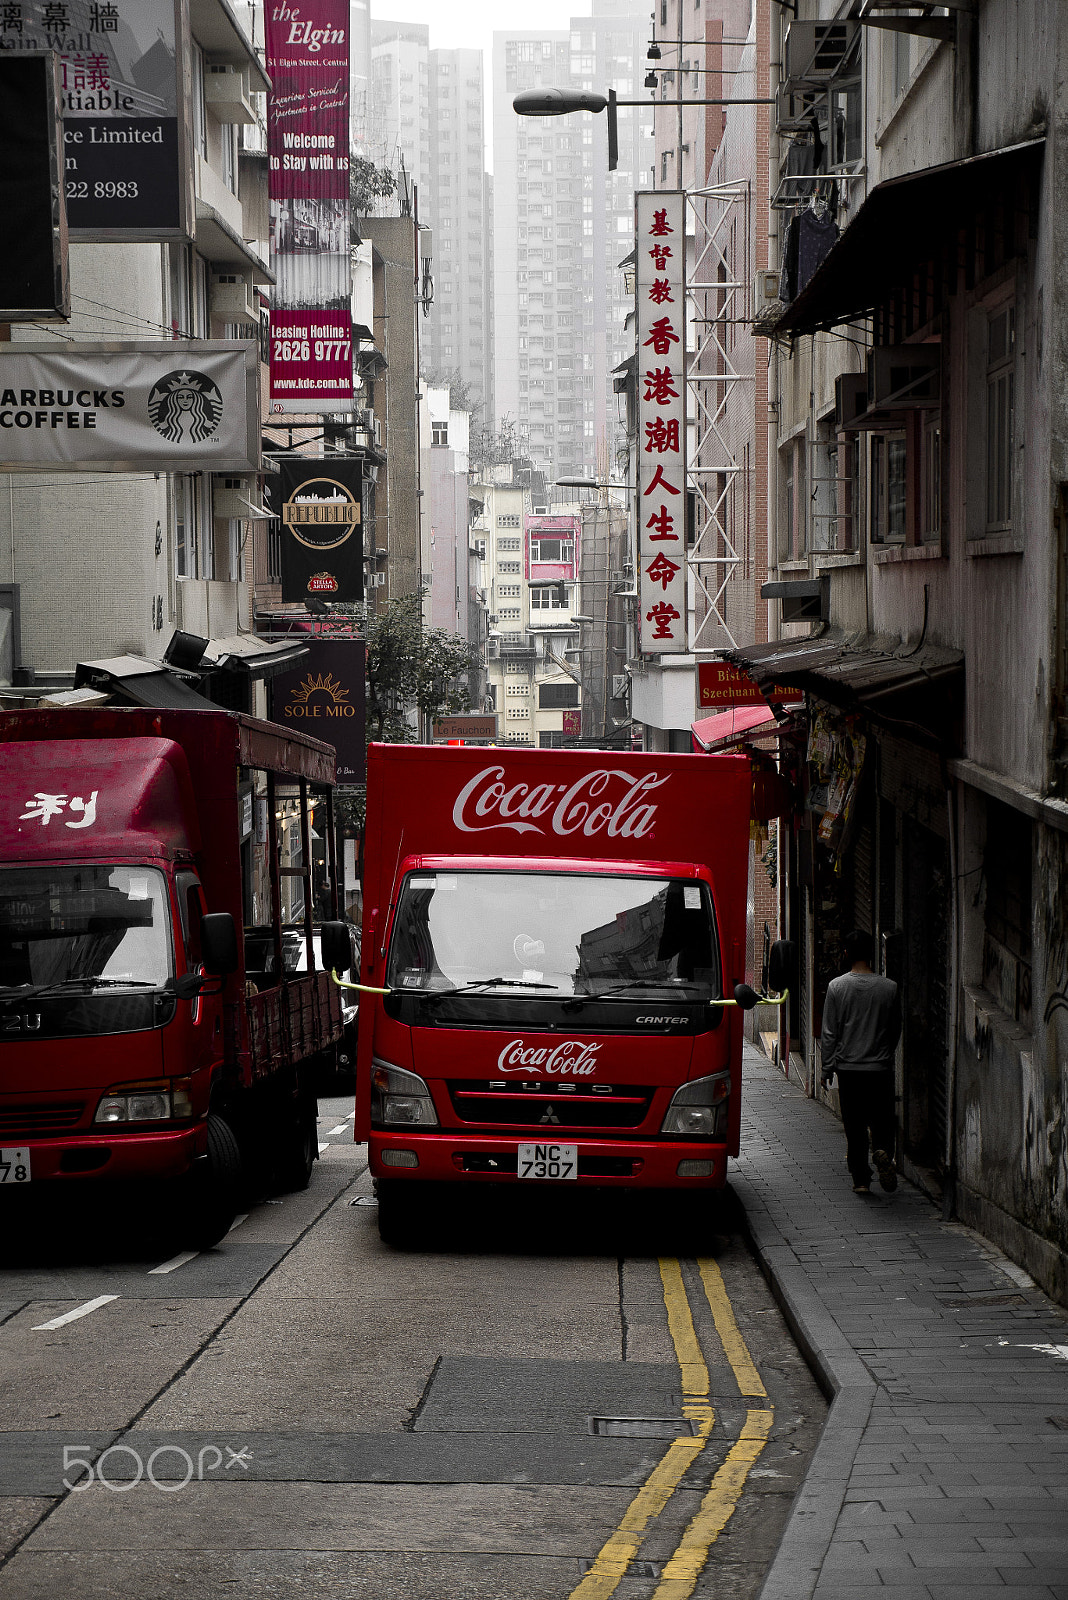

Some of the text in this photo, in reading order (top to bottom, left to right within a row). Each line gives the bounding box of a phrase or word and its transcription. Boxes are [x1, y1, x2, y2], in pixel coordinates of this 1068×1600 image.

[273, 1, 300, 22] the
[45, 33, 93, 51] Wall
[285, 20, 345, 52] Elgin
[279, 57, 298, 68] Elgin
[322, 57, 348, 67] Central
[307, 78, 342, 99] Serviced
[62, 90, 134, 111] tiable
[320, 92, 348, 110] Central
[89, 126, 164, 144] Limited
[283, 132, 335, 149] Welcome
[269, 153, 349, 175] to Stay with us
[94, 181, 139, 199] 8983
[271, 325, 308, 340] Leasing
[273, 341, 351, 362] 2626 9777
[273, 377, 350, 390] www.kdc.com.hk
[0, 410, 97, 429] COFFEE
[642, 208, 682, 639] 基督教香港潮人生命堂
[286, 505, 358, 523] REPUBLIC
[702, 686, 756, 699] Szechuan
[284, 705, 356, 718] SOLE MIO
[437, 725, 491, 735] Le Fauchon
[453, 765, 673, 839] Coca-Cola
[635, 1016, 690, 1025] CANTER
[497, 1039, 604, 1076] Coca-Cola
[488, 1081, 613, 1093] FUSO
[534, 1145, 561, 1161] NC
[521, 1161, 575, 1179] 7307
